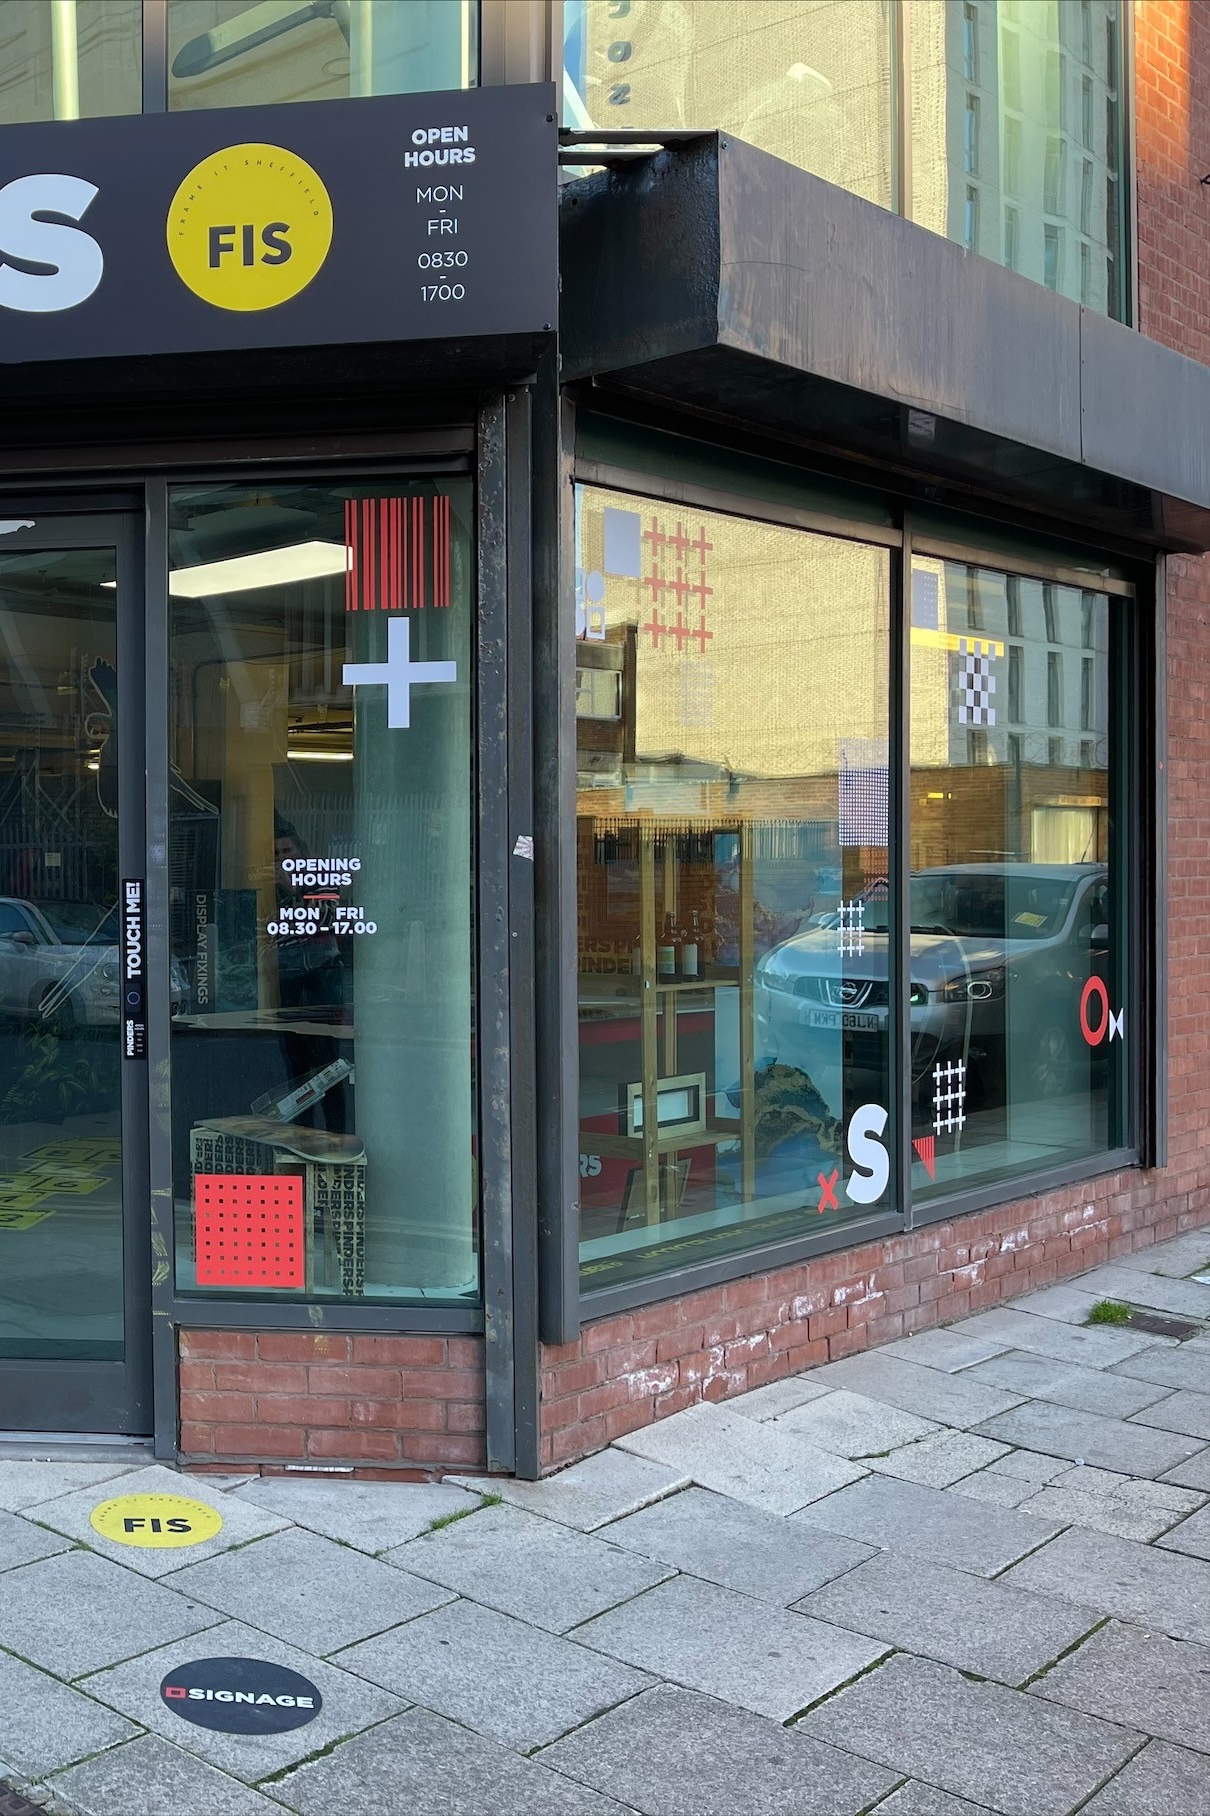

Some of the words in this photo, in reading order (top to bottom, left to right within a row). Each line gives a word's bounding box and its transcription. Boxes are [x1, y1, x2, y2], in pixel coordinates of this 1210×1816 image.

[411, 126, 468, 145] OPEN
[404, 147, 476, 168] HOURS
[178, 184, 203, 236] FRAME
[214, 165, 228, 176] IT
[244, 159, 319, 216] SHEFFIELD
[416, 185, 463, 204] MON
[427, 218, 458, 236] FRI
[208, 221, 293, 269] FIS
[417, 250, 469, 269] 0830
[420, 283, 465, 302] 1700
[281, 857, 362, 872] OPENING
[291, 873, 353, 887] HOURS
[126, 881, 141, 912] ME!
[195, 894, 208, 949] DISPLAY
[279, 907, 320, 920] MON
[336, 907, 364, 920] FRI
[266, 921, 317, 935] 08.30
[334, 921, 378, 935] 17.00
[126, 916, 142, 979] TOUCH
[196, 951, 209, 1005] FIXINGS
[126, 1019, 135, 1056] PINDERS
[123, 1517, 192, 1533] FIS
[188, 1688, 315, 1709] SIGNAGE
